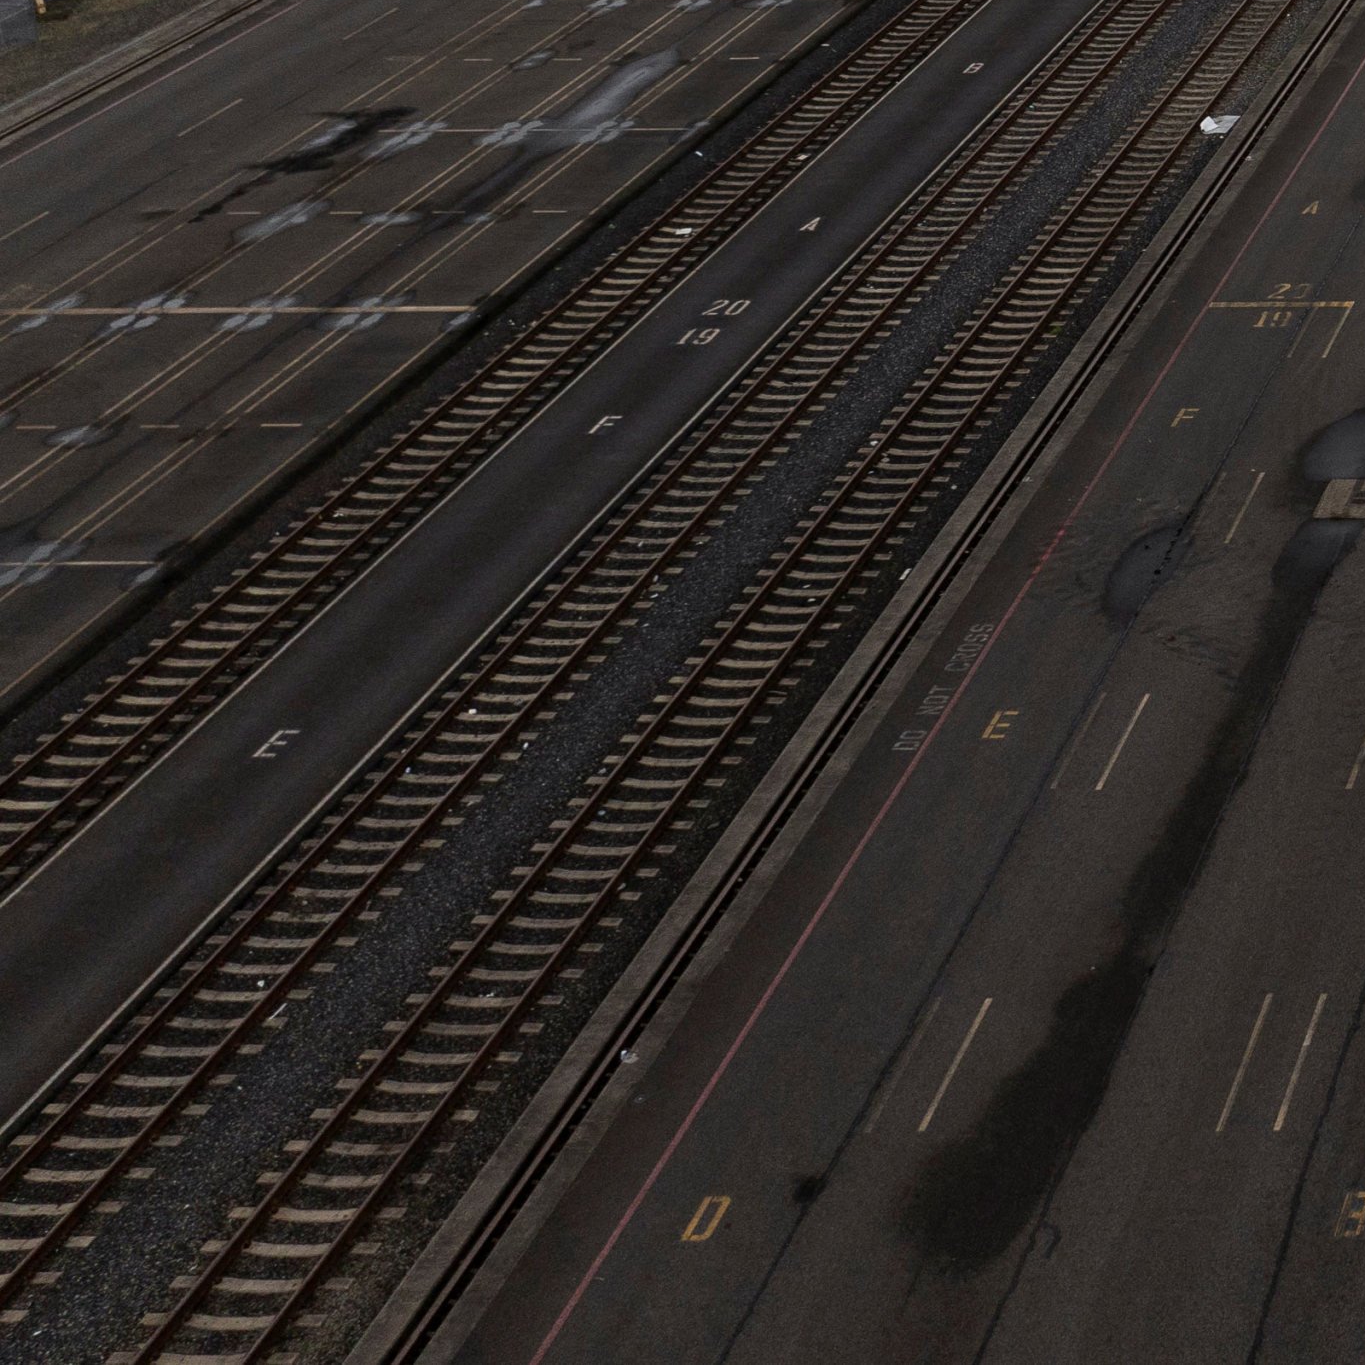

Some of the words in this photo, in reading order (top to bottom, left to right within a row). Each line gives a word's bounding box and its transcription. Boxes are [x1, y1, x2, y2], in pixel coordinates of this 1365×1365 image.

[962, 62, 985, 74] B
[1301, 200, 1320, 215] A
[799, 216, 821, 231] A
[702, 299, 751, 317] 20
[1250, 309, 1293, 329] 19
[674, 328, 721, 345] 19
[588, 415, 623, 434] F
[1170, 407, 1200, 428] F
[891, 730, 927, 752] DO
[915, 684, 950, 717] NOT
[945, 623, 995, 674] CROSS
[981, 710, 1020, 739] E
[252, 729, 301, 758] E
[680, 1195, 732, 1242] D
